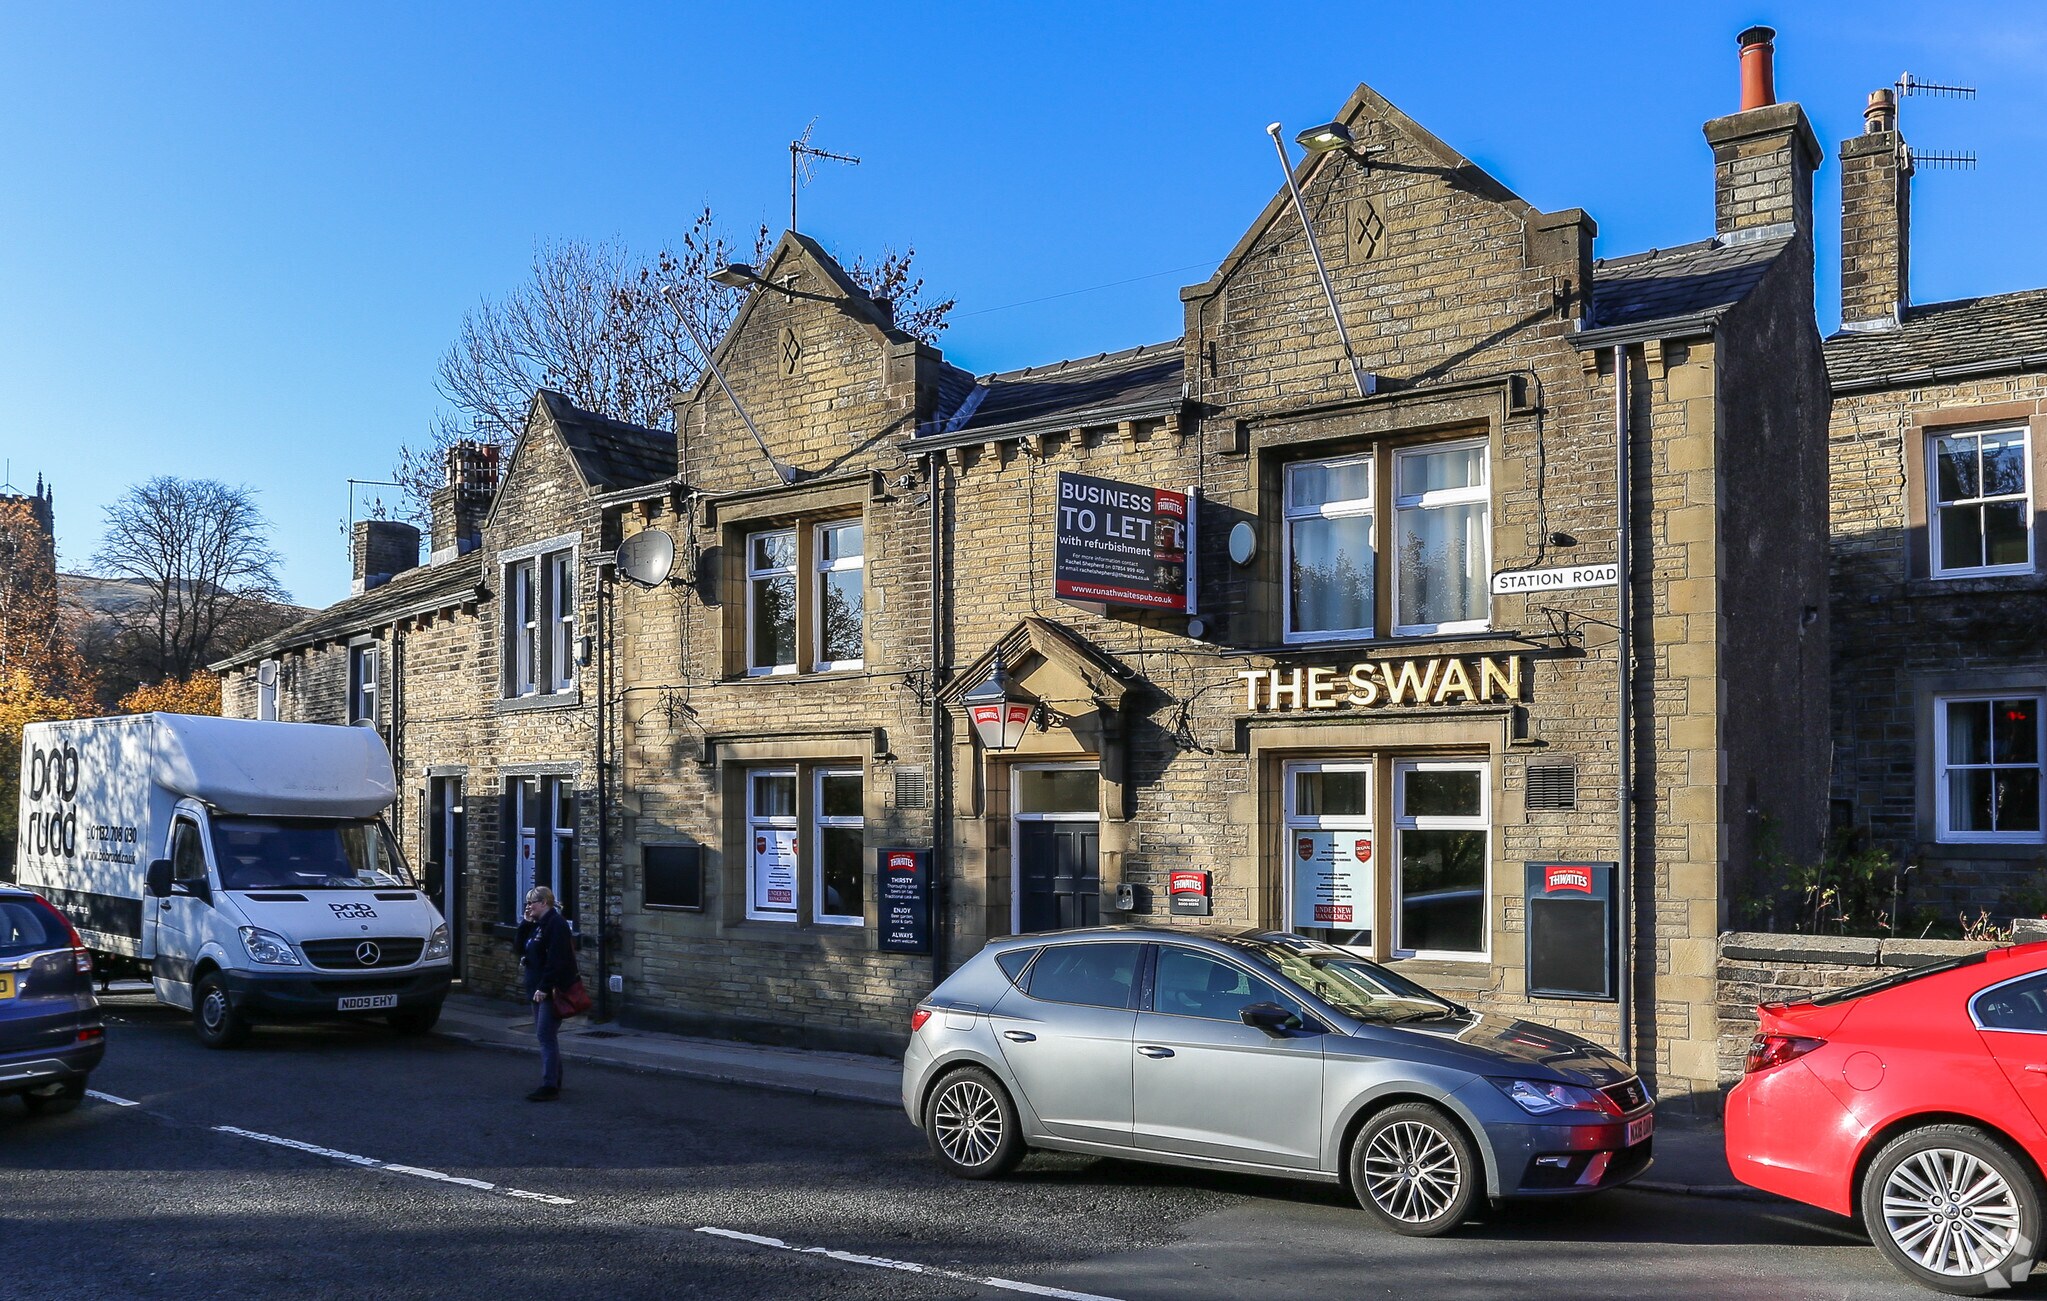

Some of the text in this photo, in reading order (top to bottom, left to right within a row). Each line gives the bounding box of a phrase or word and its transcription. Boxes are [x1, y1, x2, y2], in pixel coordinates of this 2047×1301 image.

[1062, 482, 1152, 512] BUSINESS
[1157, 500, 1183, 514] THWAITES
[1061, 506, 1152, 541] TO LET
[1059, 535, 1151, 556] with refurbishment
[1499, 568, 1617, 590] STATION ROAD
[1072, 584, 1172, 604] www.runathwaitespub.co.uk
[1238, 655, 1521, 711] THE SWAN
[28, 802, 76, 858] rudd
[125, 827, 137, 844] 030
[1173, 879, 1202, 890] THWAITES
[1548, 874, 1588, 887] THWAITES
[334, 910, 378, 919] rudd
[1315, 905, 1336, 913] UNDER
[342, 995, 394, 1008] ND09 EHY
